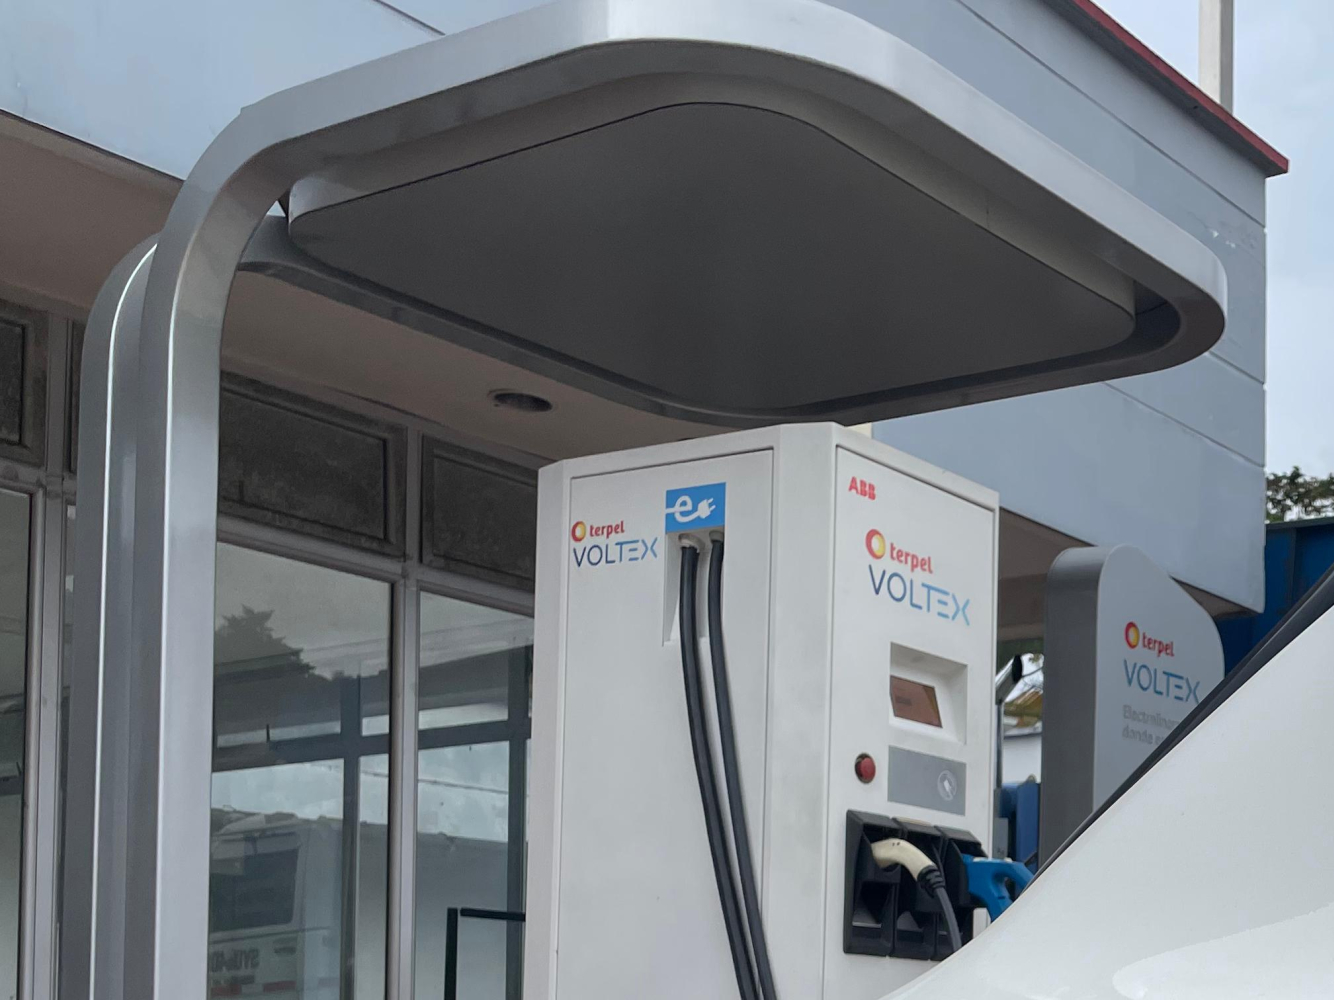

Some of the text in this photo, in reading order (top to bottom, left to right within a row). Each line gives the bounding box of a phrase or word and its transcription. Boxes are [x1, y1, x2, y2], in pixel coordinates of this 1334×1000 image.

[848, 476, 876, 500] ABB
[589, 520, 625, 539] terpel
[573, 537, 658, 568] VOLTEX
[890, 542, 933, 574] terpel
[869, 564, 970, 626] VOLTEX
[1142, 632, 1175, 657] terpel
[1123, 658, 1200, 704] VOLTEX
